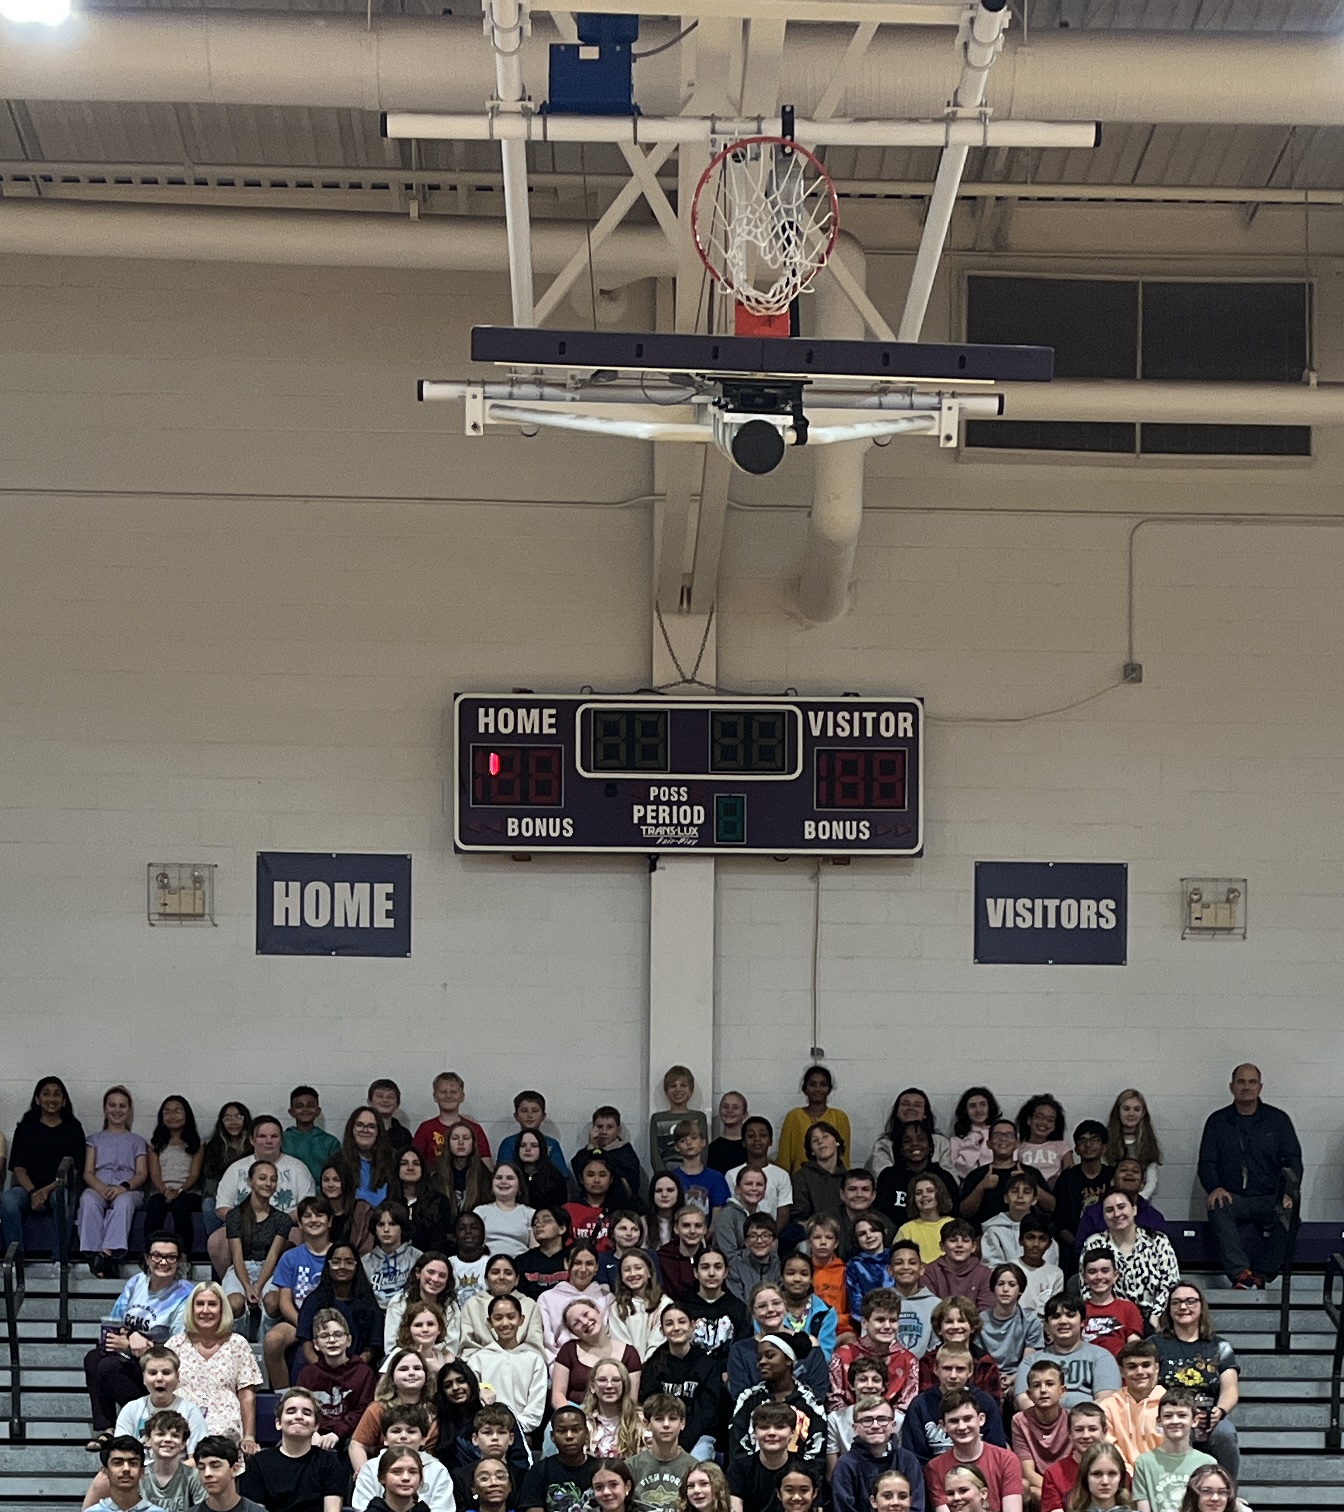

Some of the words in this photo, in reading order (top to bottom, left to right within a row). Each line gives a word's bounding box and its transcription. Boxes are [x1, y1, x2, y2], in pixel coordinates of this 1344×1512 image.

[479, 708, 557, 734] HOME
[808, 712, 913, 738] VISITOR
[650, 786, 688, 801] POSS
[633, 805, 705, 824] PERIOD
[507, 817, 574, 837] BONUS
[804, 820, 870, 840] BONUS
[273, 881, 394, 928] HOME
[985, 898, 1117, 930] VISITORS
[640, 1473, 660, 1487] FISH
[662, 1473, 682, 1486] MOR
